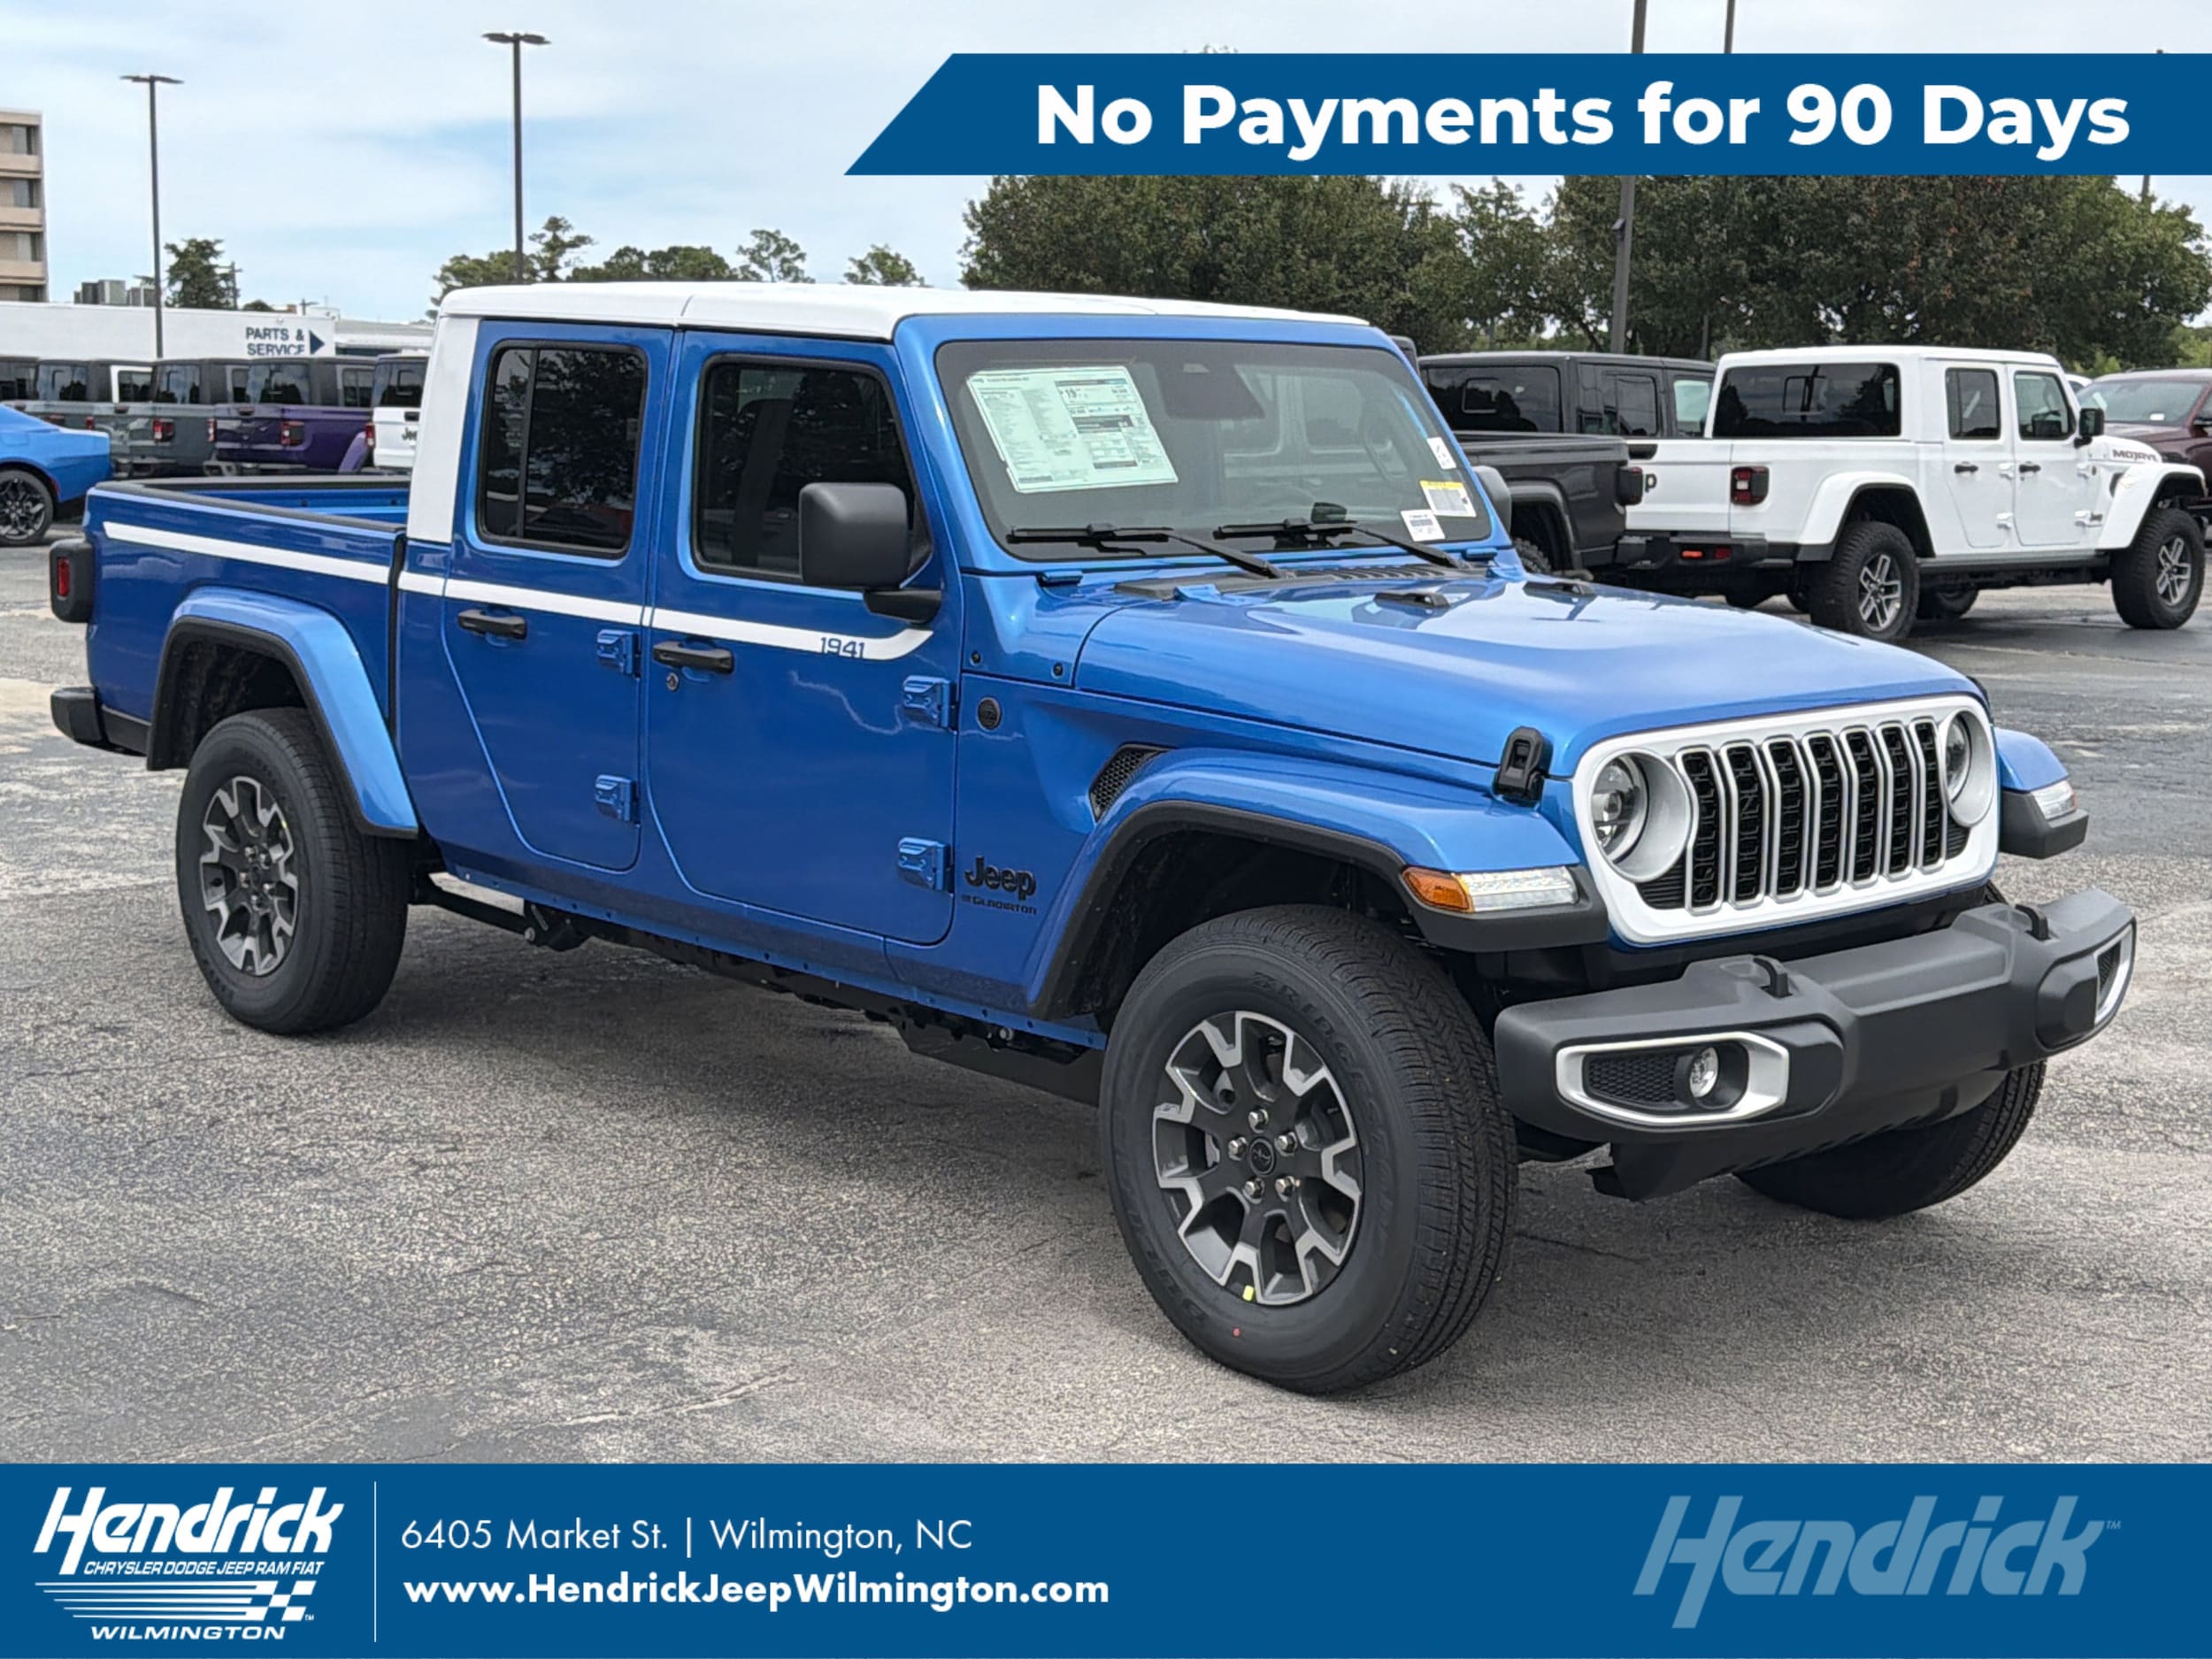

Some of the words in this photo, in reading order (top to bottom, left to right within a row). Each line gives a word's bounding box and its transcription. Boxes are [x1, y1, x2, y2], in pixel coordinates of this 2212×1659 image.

[246, 326, 289, 341] PARTS
[296, 328, 304, 342] &
[247, 342, 305, 356] SERVICE
[821, 637, 865, 658] 1941
[964, 855, 1036, 901] Jeep
